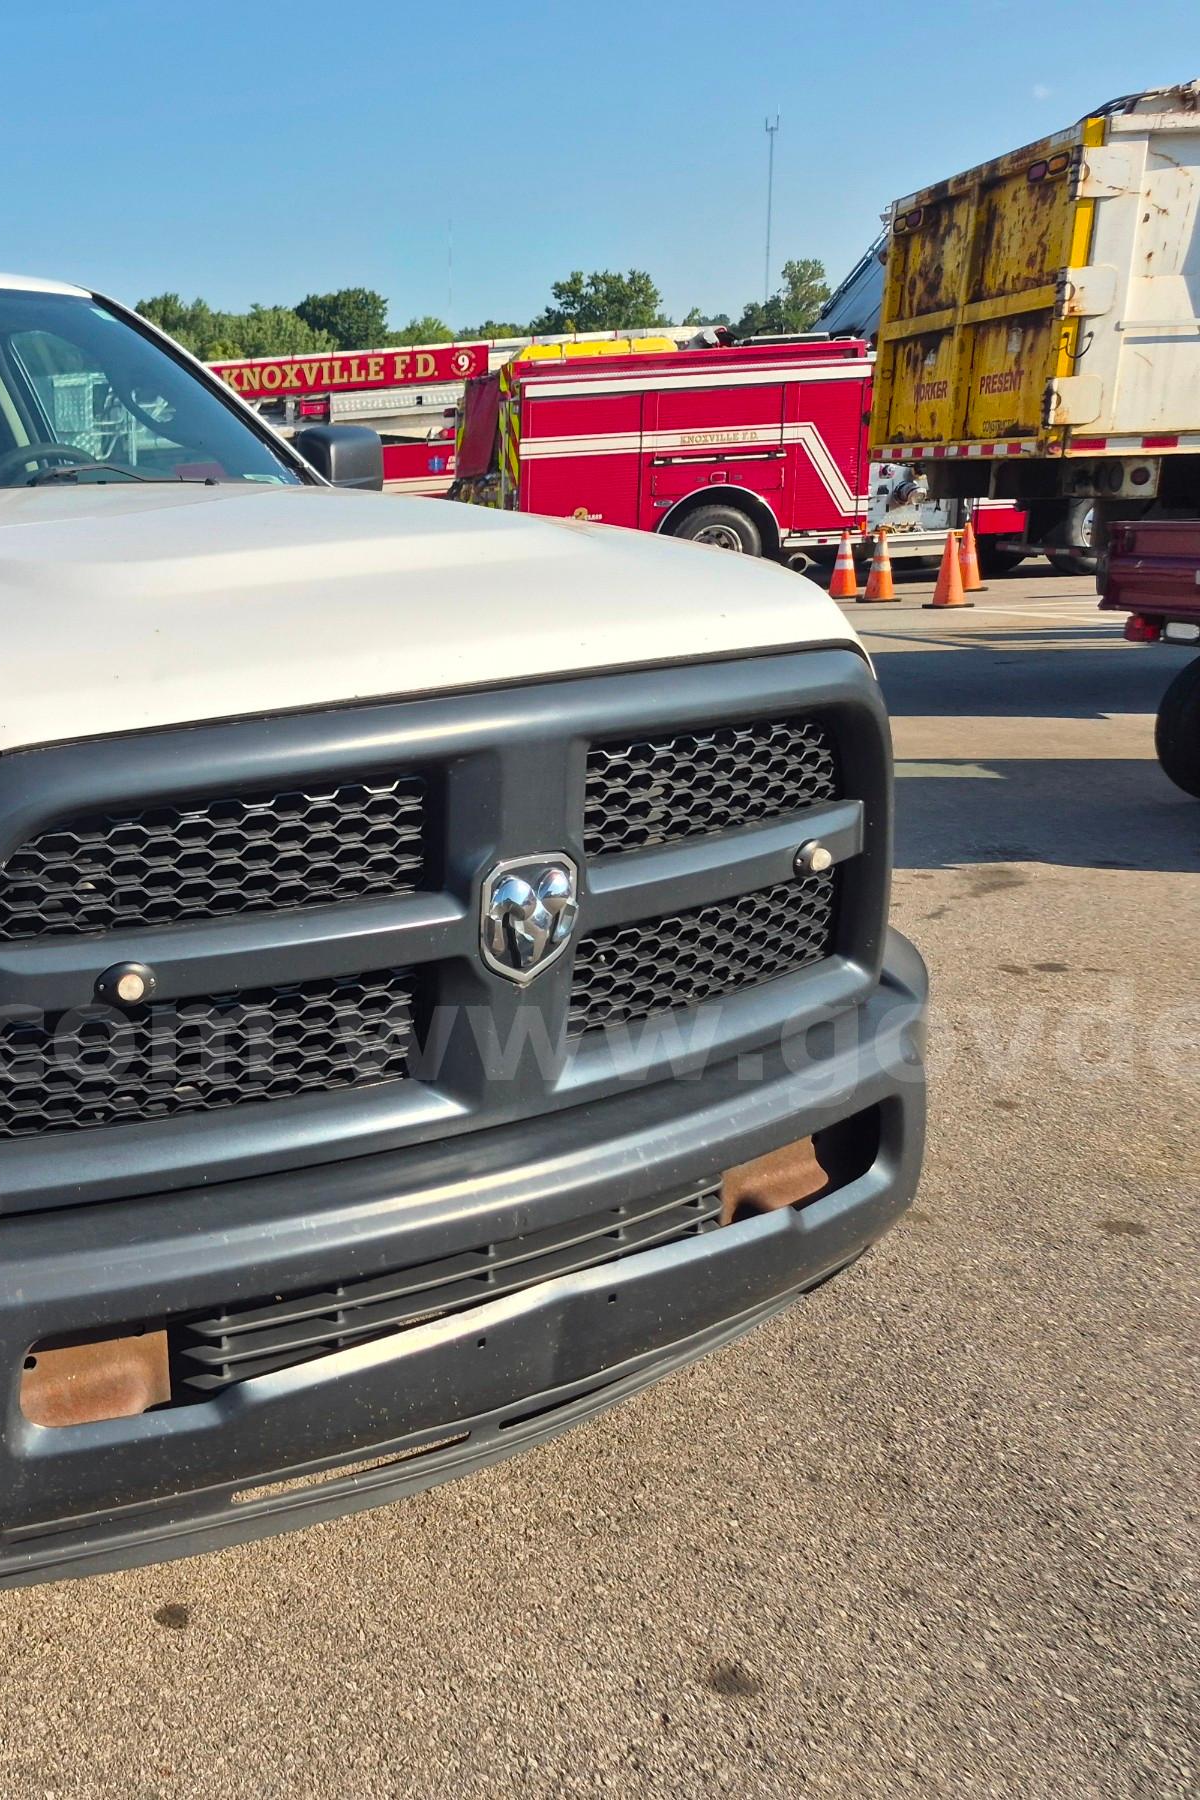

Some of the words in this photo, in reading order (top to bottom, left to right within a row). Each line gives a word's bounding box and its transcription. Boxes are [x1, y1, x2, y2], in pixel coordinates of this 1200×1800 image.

[221, 357, 384, 392] KNOXVILLE
[394, 353, 439, 379] F.D.
[457, 355, 469, 372] 9
[914, 380, 948, 402] WORKER
[980, 369, 1025, 395] PRESENT
[680, 432, 740, 445] KNOXVILLE
